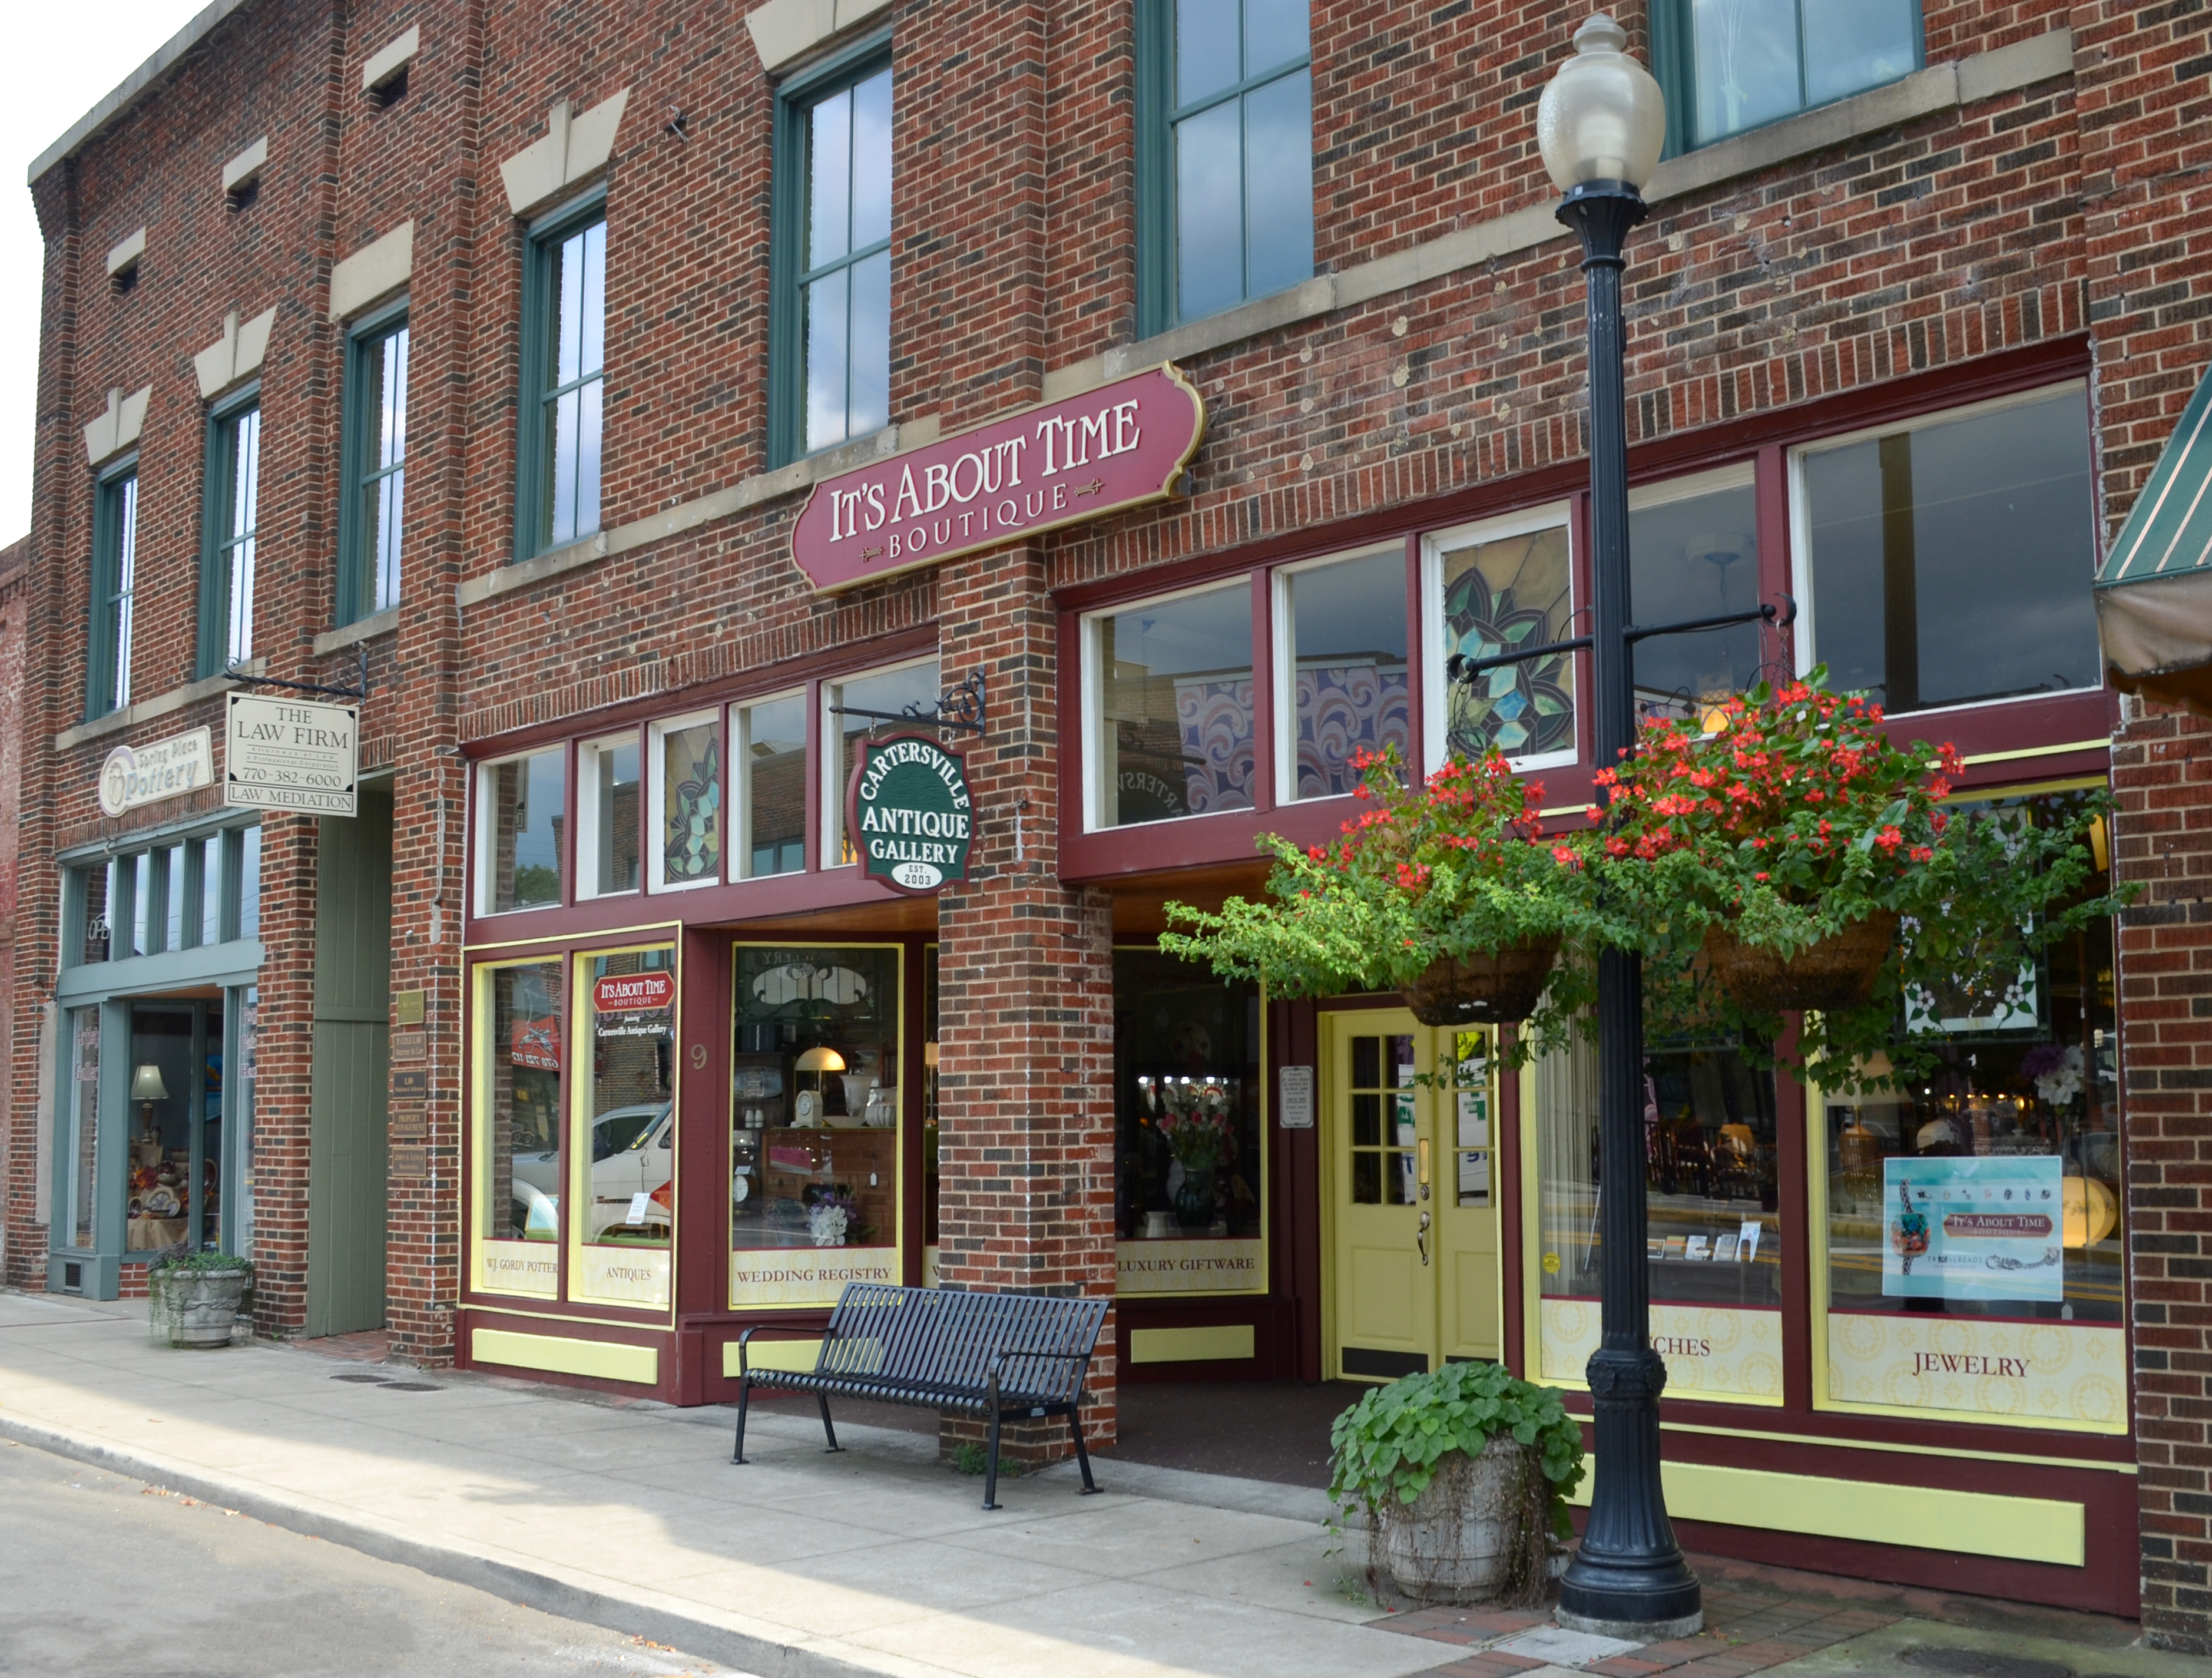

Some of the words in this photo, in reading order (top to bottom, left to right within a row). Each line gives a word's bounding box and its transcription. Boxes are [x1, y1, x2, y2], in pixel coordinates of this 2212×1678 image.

[829, 482, 886, 542] IT'S
[890, 434, 1026, 525] ABOUT
[1037, 399, 1141, 476] TIME
[889, 483, 1068, 559] BOUTIQUE
[276, 707, 313, 724] THE
[237, 721, 285, 741] LAW
[293, 727, 349, 749] FIRM
[251, 746, 298, 756] Attorneys
[254, 756, 297, 765] Professional
[299, 760, 339, 769] Corporation
[125, 760, 198, 800] Pottery
[242, 767, 342, 787] 770-382-6000
[860, 742, 969, 809] CARTERSVILLE
[231, 787, 263, 800] LAW
[269, 790, 352, 809] MEDIATION
[862, 806, 969, 839] ANTIQUE
[870, 839, 958, 863] GALLERY
[909, 865, 927, 873] EST.
[905, 874, 931, 885] 2003
[601, 984, 615, 998] IT'S
[615, 981, 644, 997] ABOUT
[645, 979, 665, 995] TIME
[614, 997, 651, 1007] BOUTIQUE
[598, 1026, 625, 1037] Cartersville
[627, 1026, 647, 1037] Antique
[648, 1024, 667, 1035] Gallery
[691, 1044, 707, 1070] 9
[1954, 1216, 1973, 1226] IT'S
[1977, 1216, 2014, 1227] ABOUT
[2017, 1216, 2045, 1227] TIME
[486, 1258, 498, 1272] W.J.
[500, 1259, 526, 1271] GORDY
[606, 1267, 651, 1282] ANTIQUES
[1117, 1259, 1177, 1272] LUXURY
[1180, 1258, 1254, 1271] GIFTWARE
[738, 1270, 814, 1283] WEDDING
[818, 1267, 891, 1281] REGISTRY
[1650, 1336, 1710, 1356] CHES
[1912, 1352, 2031, 1378] JEWELRY
